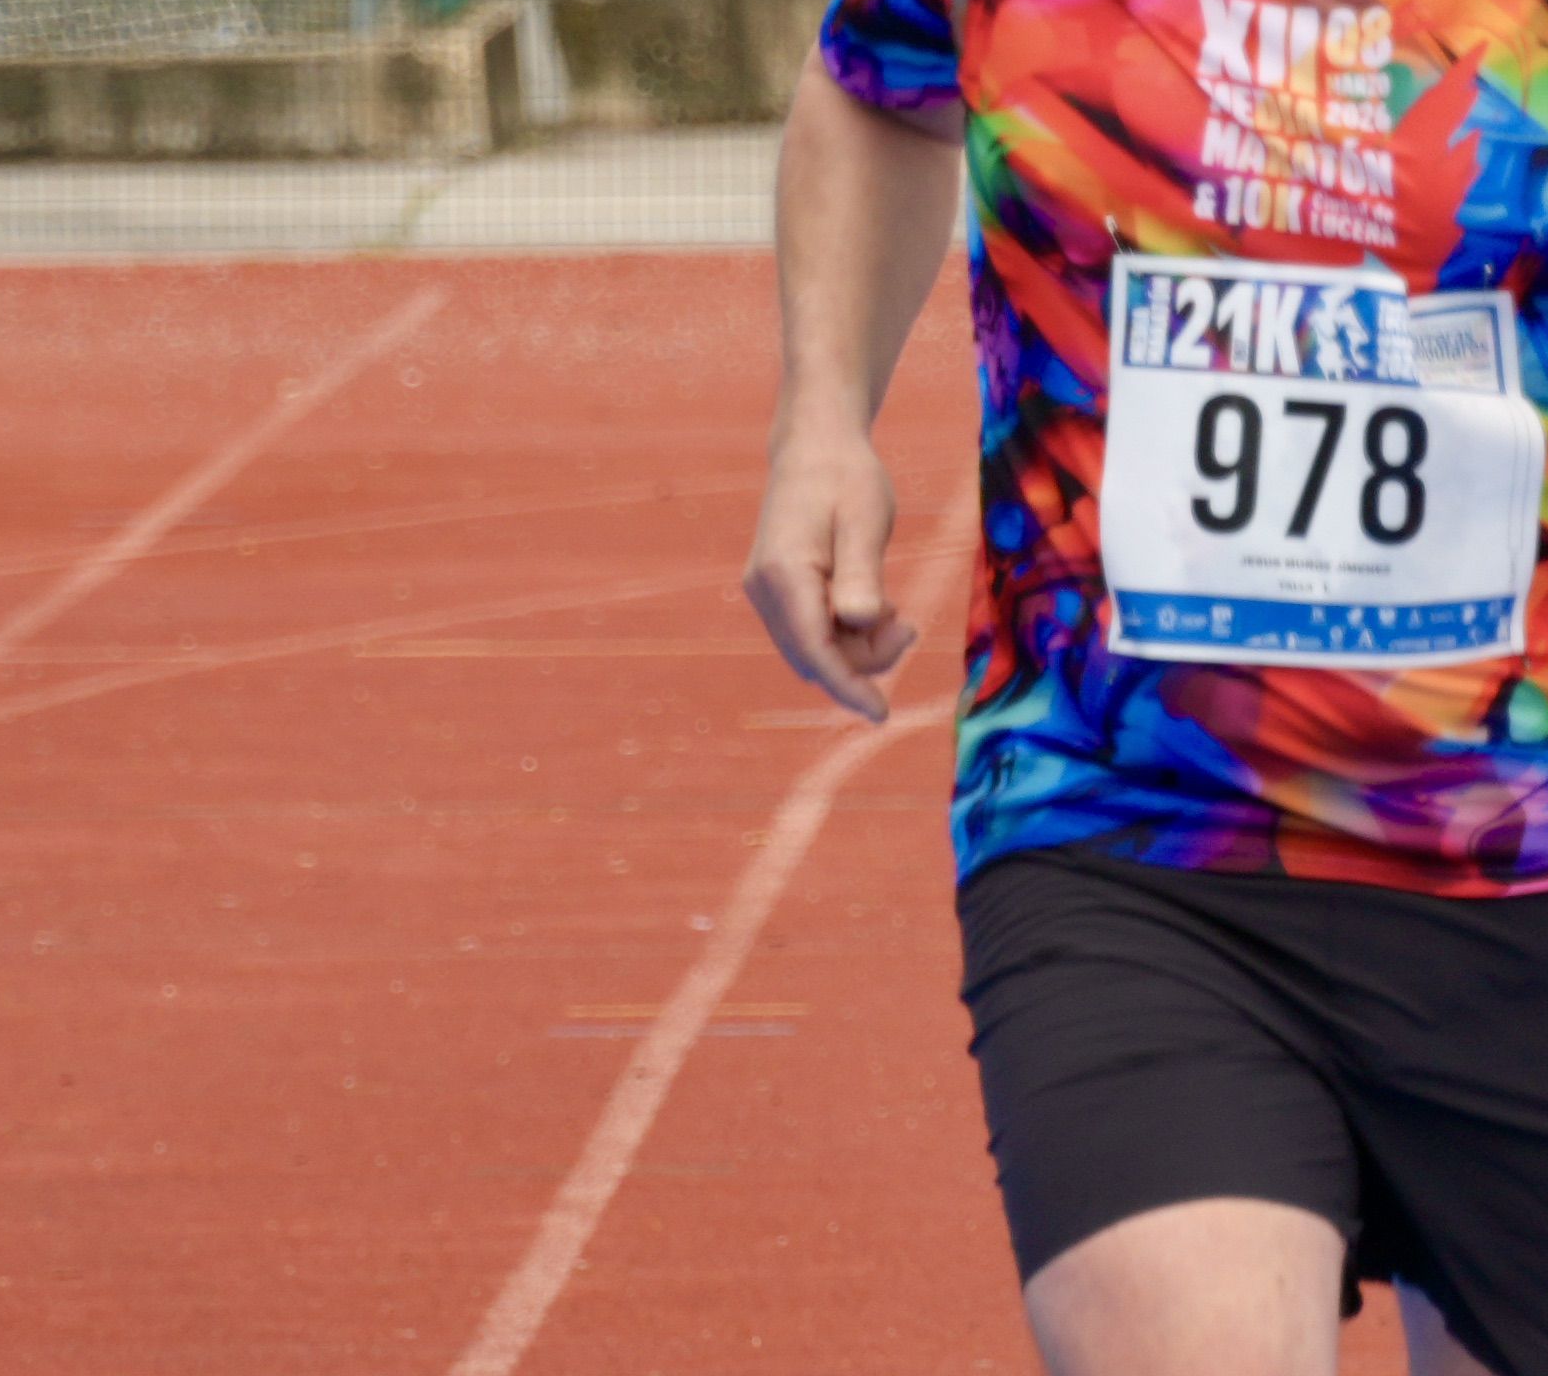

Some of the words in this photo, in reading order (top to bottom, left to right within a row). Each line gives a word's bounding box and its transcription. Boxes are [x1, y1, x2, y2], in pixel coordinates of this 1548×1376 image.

[1224, 175, 1304, 234] 10K
[1169, 276, 1305, 376] 21K
[1190, 393, 1429, 546] 978
